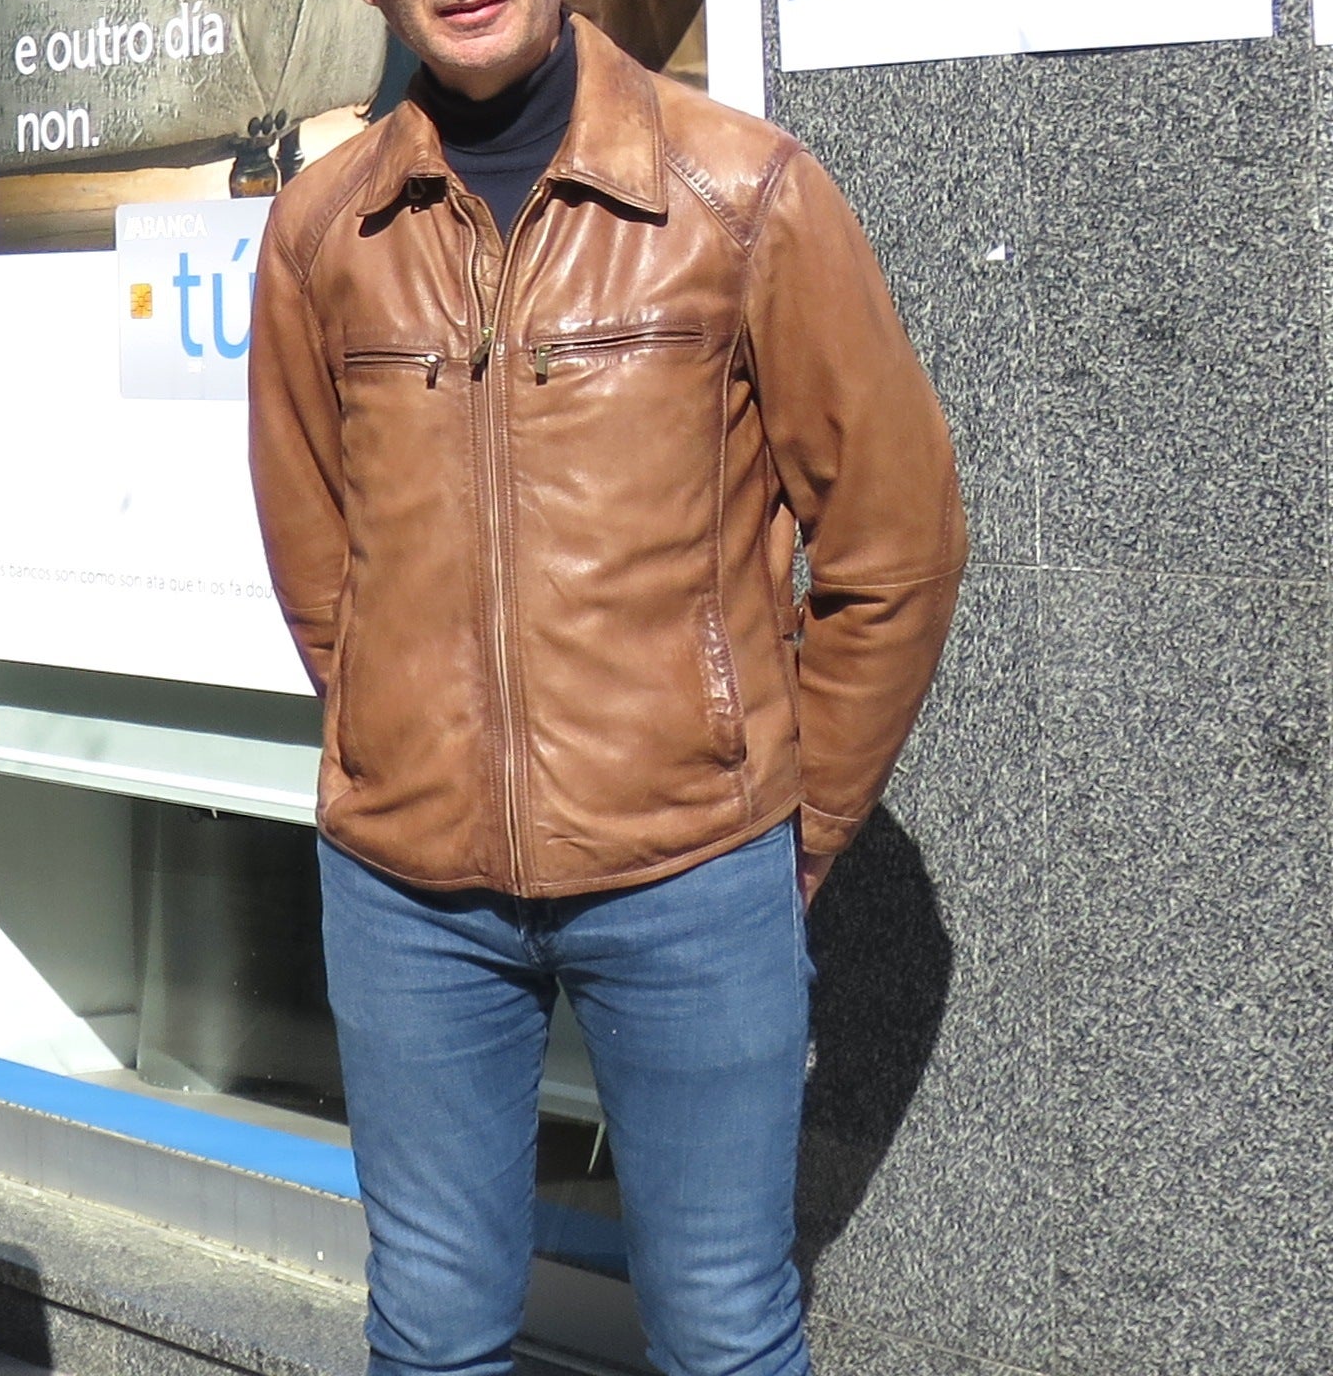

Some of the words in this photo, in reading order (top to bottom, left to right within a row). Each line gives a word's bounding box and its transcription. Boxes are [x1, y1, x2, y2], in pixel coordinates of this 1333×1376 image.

[14, 34, 38, 76] e
[46, 16, 154, 72] outro
[164, 0, 225, 60] día
[17, 107, 100, 153] non.
[172, 238, 258, 360] tú
[80, 571, 116, 586] como
[119, 575, 142, 588] son
